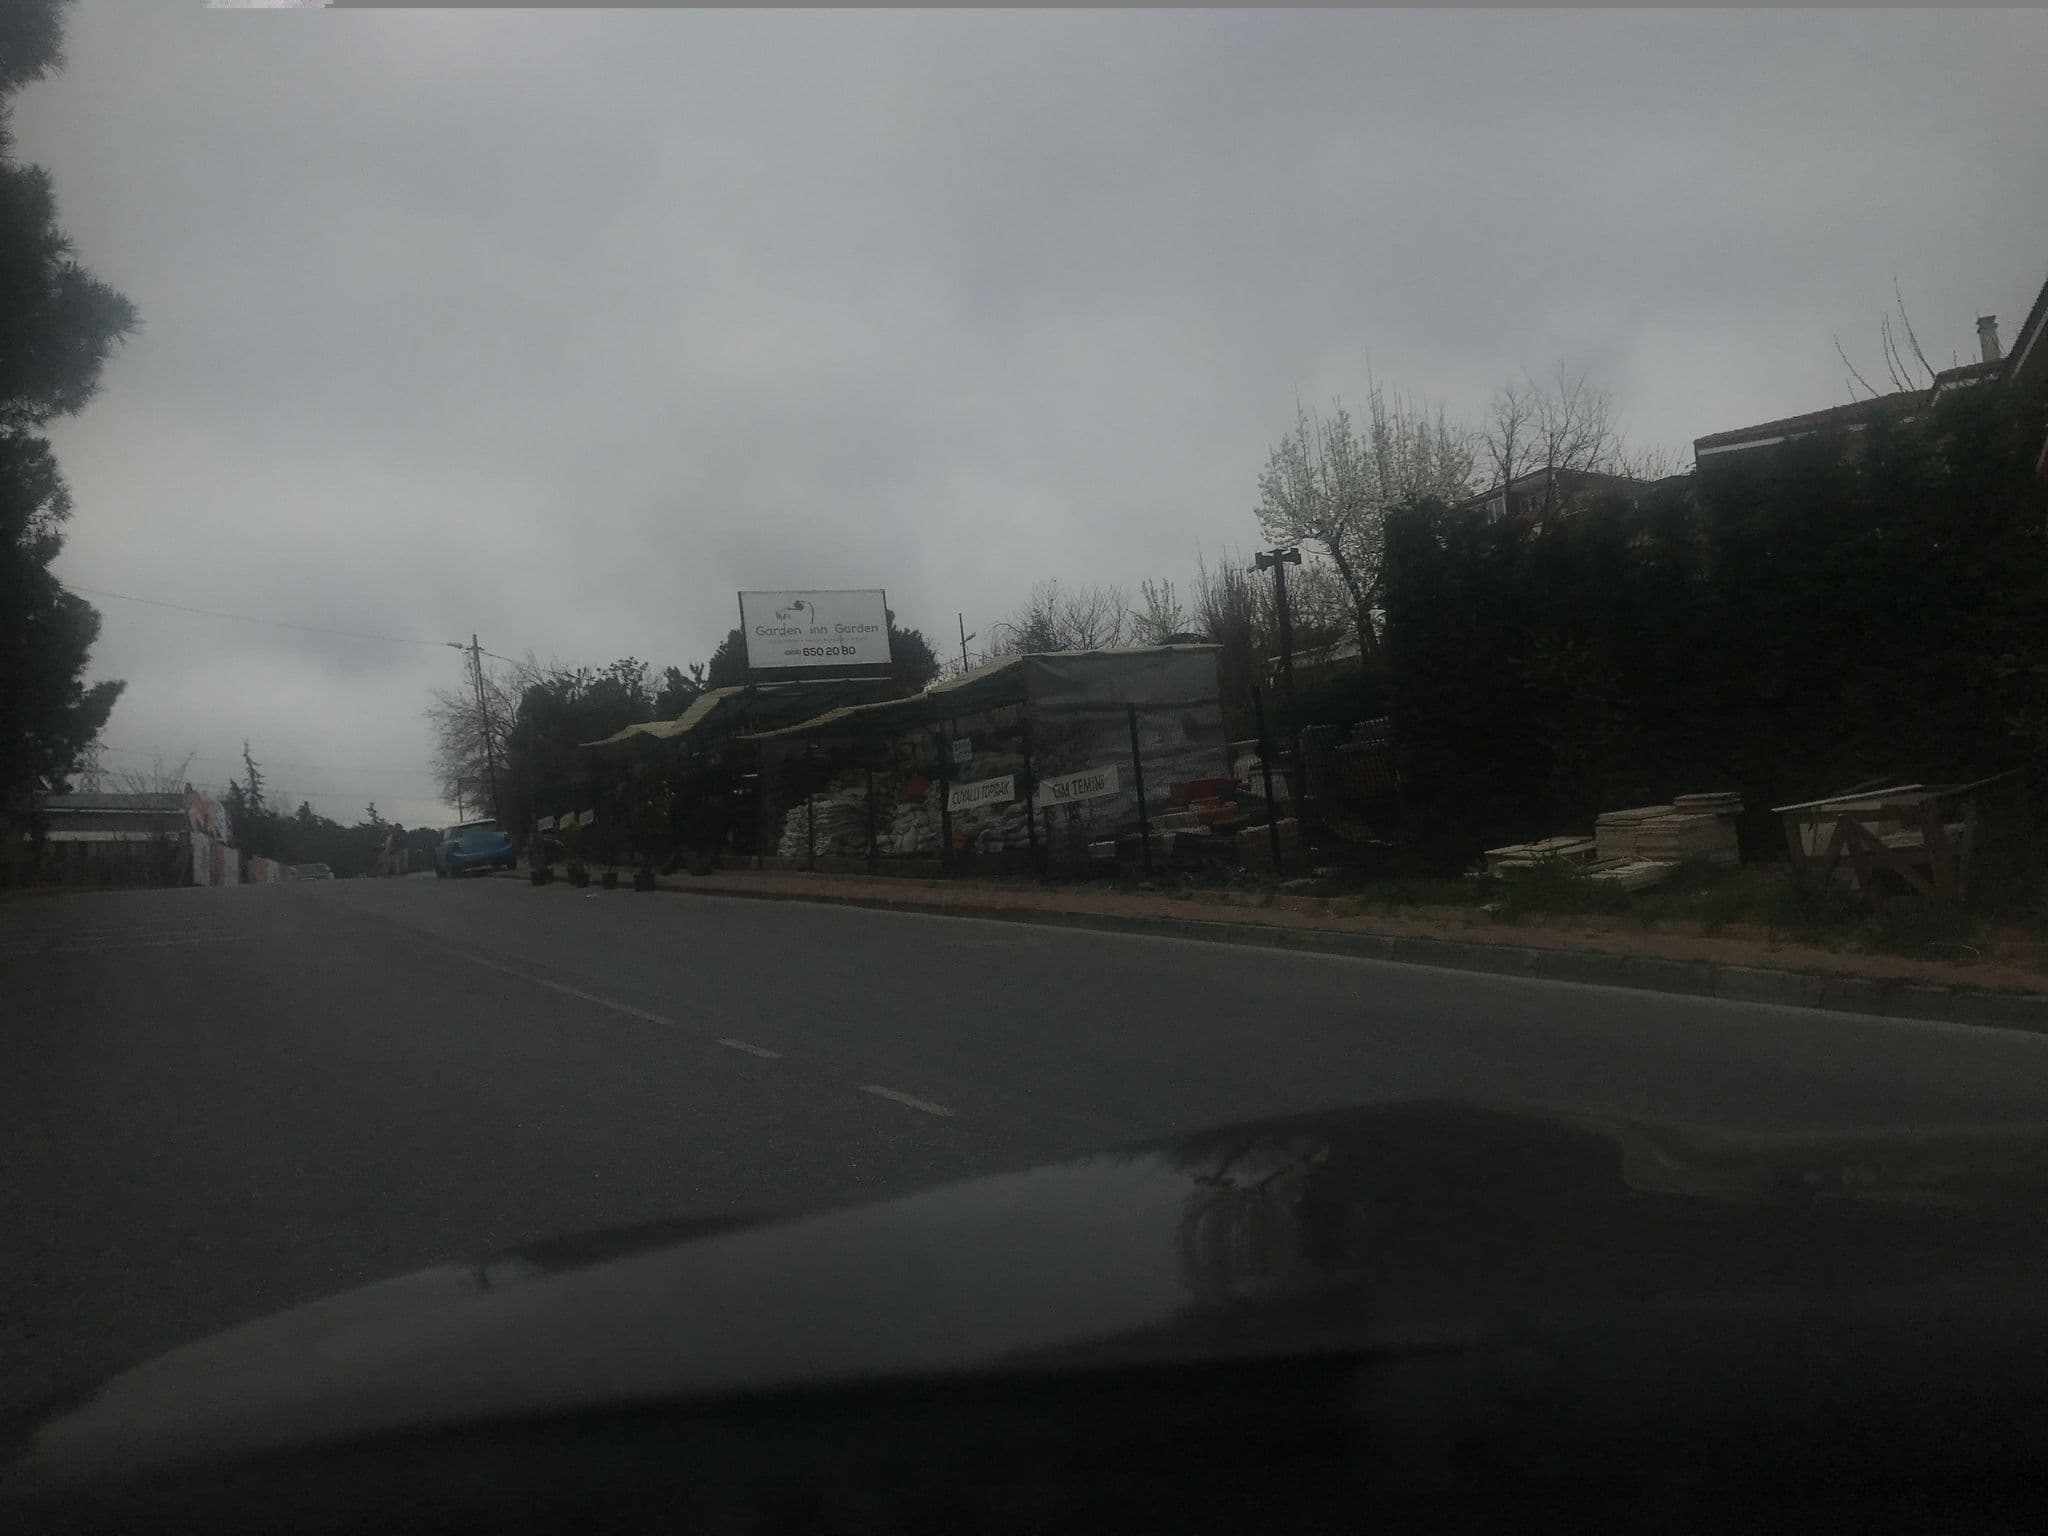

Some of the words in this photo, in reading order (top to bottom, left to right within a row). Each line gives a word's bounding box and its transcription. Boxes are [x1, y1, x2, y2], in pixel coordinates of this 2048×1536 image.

[756, 624, 801, 636] Garden
[810, 624, 829, 635] inn
[835, 623, 879, 634] Garden
[803, 647, 824, 657] 650
[826, 647, 840, 656] 20
[842, 646, 856, 656] 80
